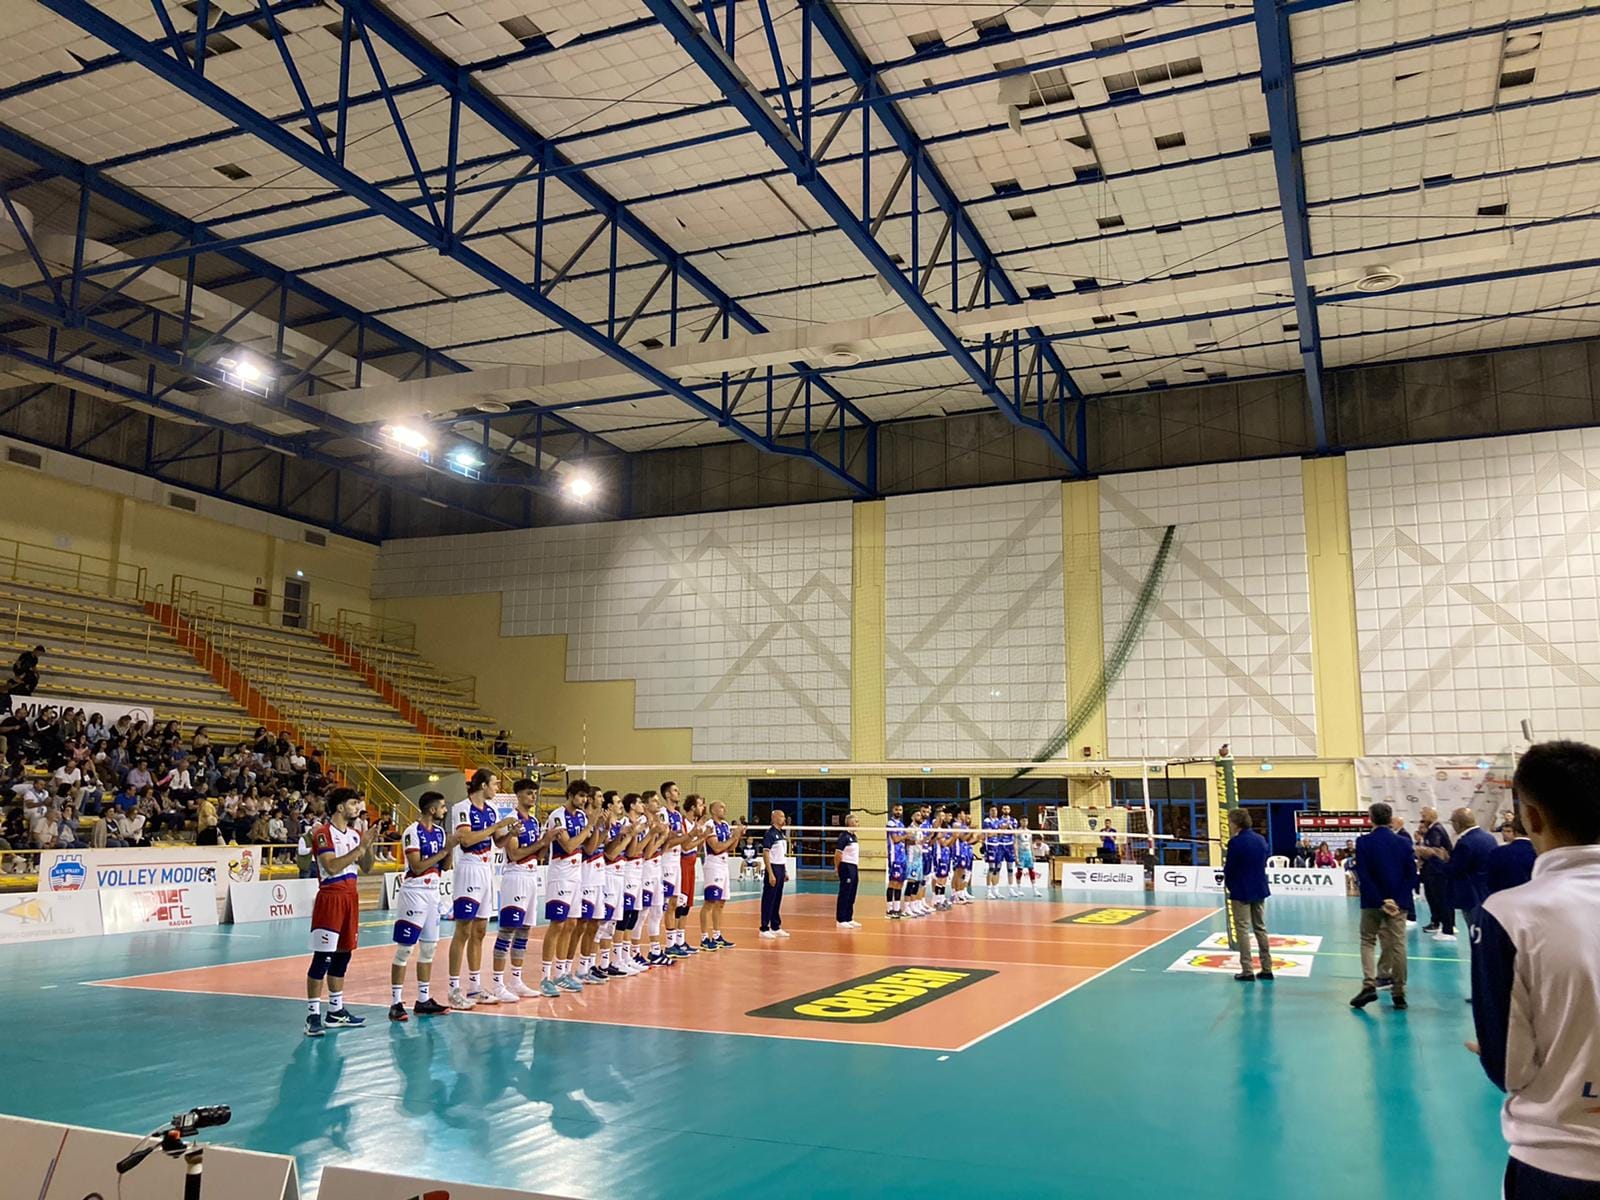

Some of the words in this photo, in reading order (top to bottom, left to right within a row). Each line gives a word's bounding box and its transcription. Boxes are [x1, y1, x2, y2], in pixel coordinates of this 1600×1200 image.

[20, 702, 87, 721] MSIA
[97, 868, 157, 887] VOLLEY
[1267, 873, 1333, 886] LEOCATA
[269, 903, 294, 917] RTM
[793, 967, 971, 1018] CREDEM
